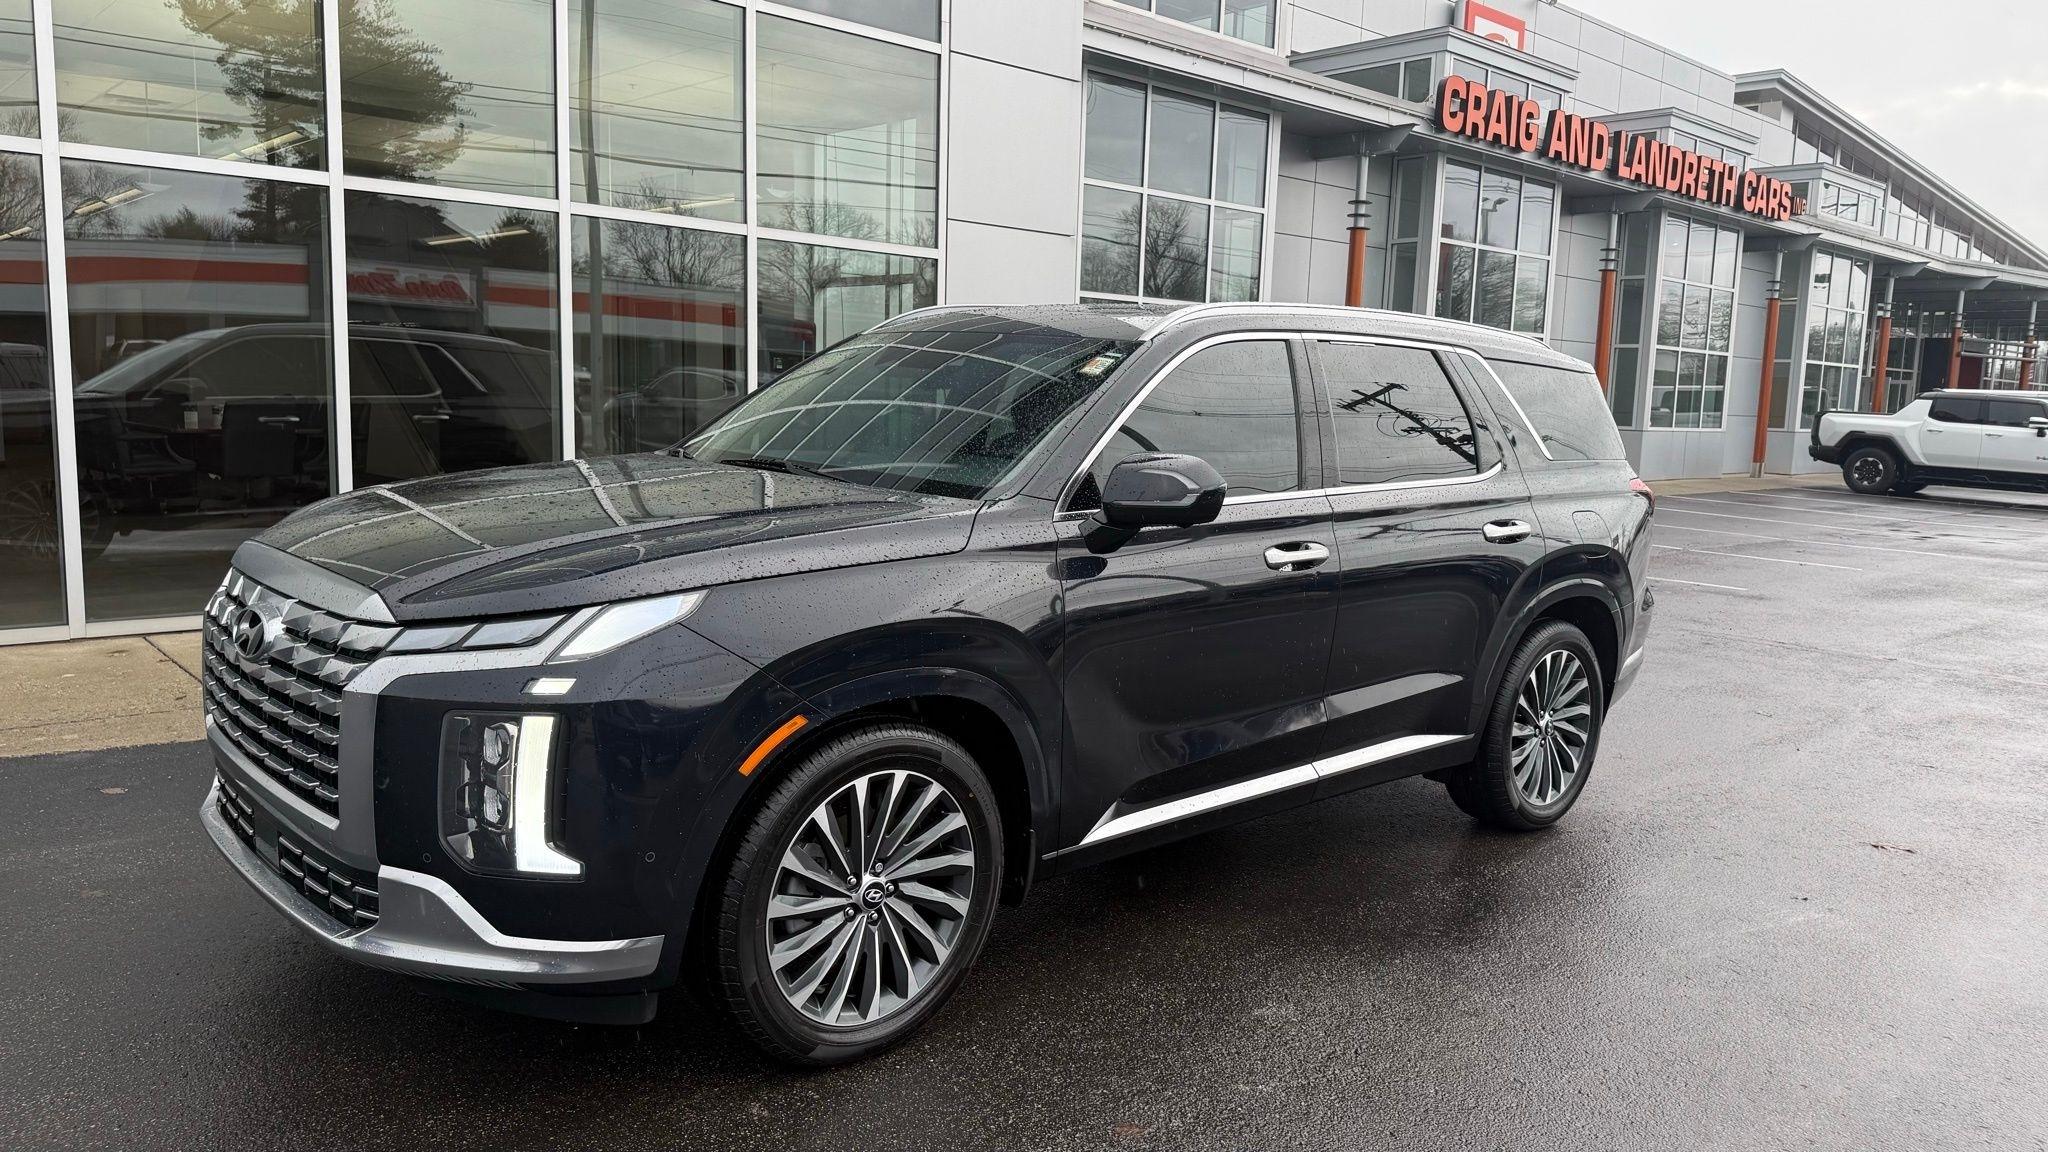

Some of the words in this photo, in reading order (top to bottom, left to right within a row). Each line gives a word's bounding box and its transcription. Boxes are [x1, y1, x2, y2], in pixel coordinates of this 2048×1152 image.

[1442, 75, 1540, 152] CRAIG
[1548, 109, 1609, 171] AND
[1618, 130, 1738, 207] LANDRETH
[1743, 170, 1792, 222] CARS
